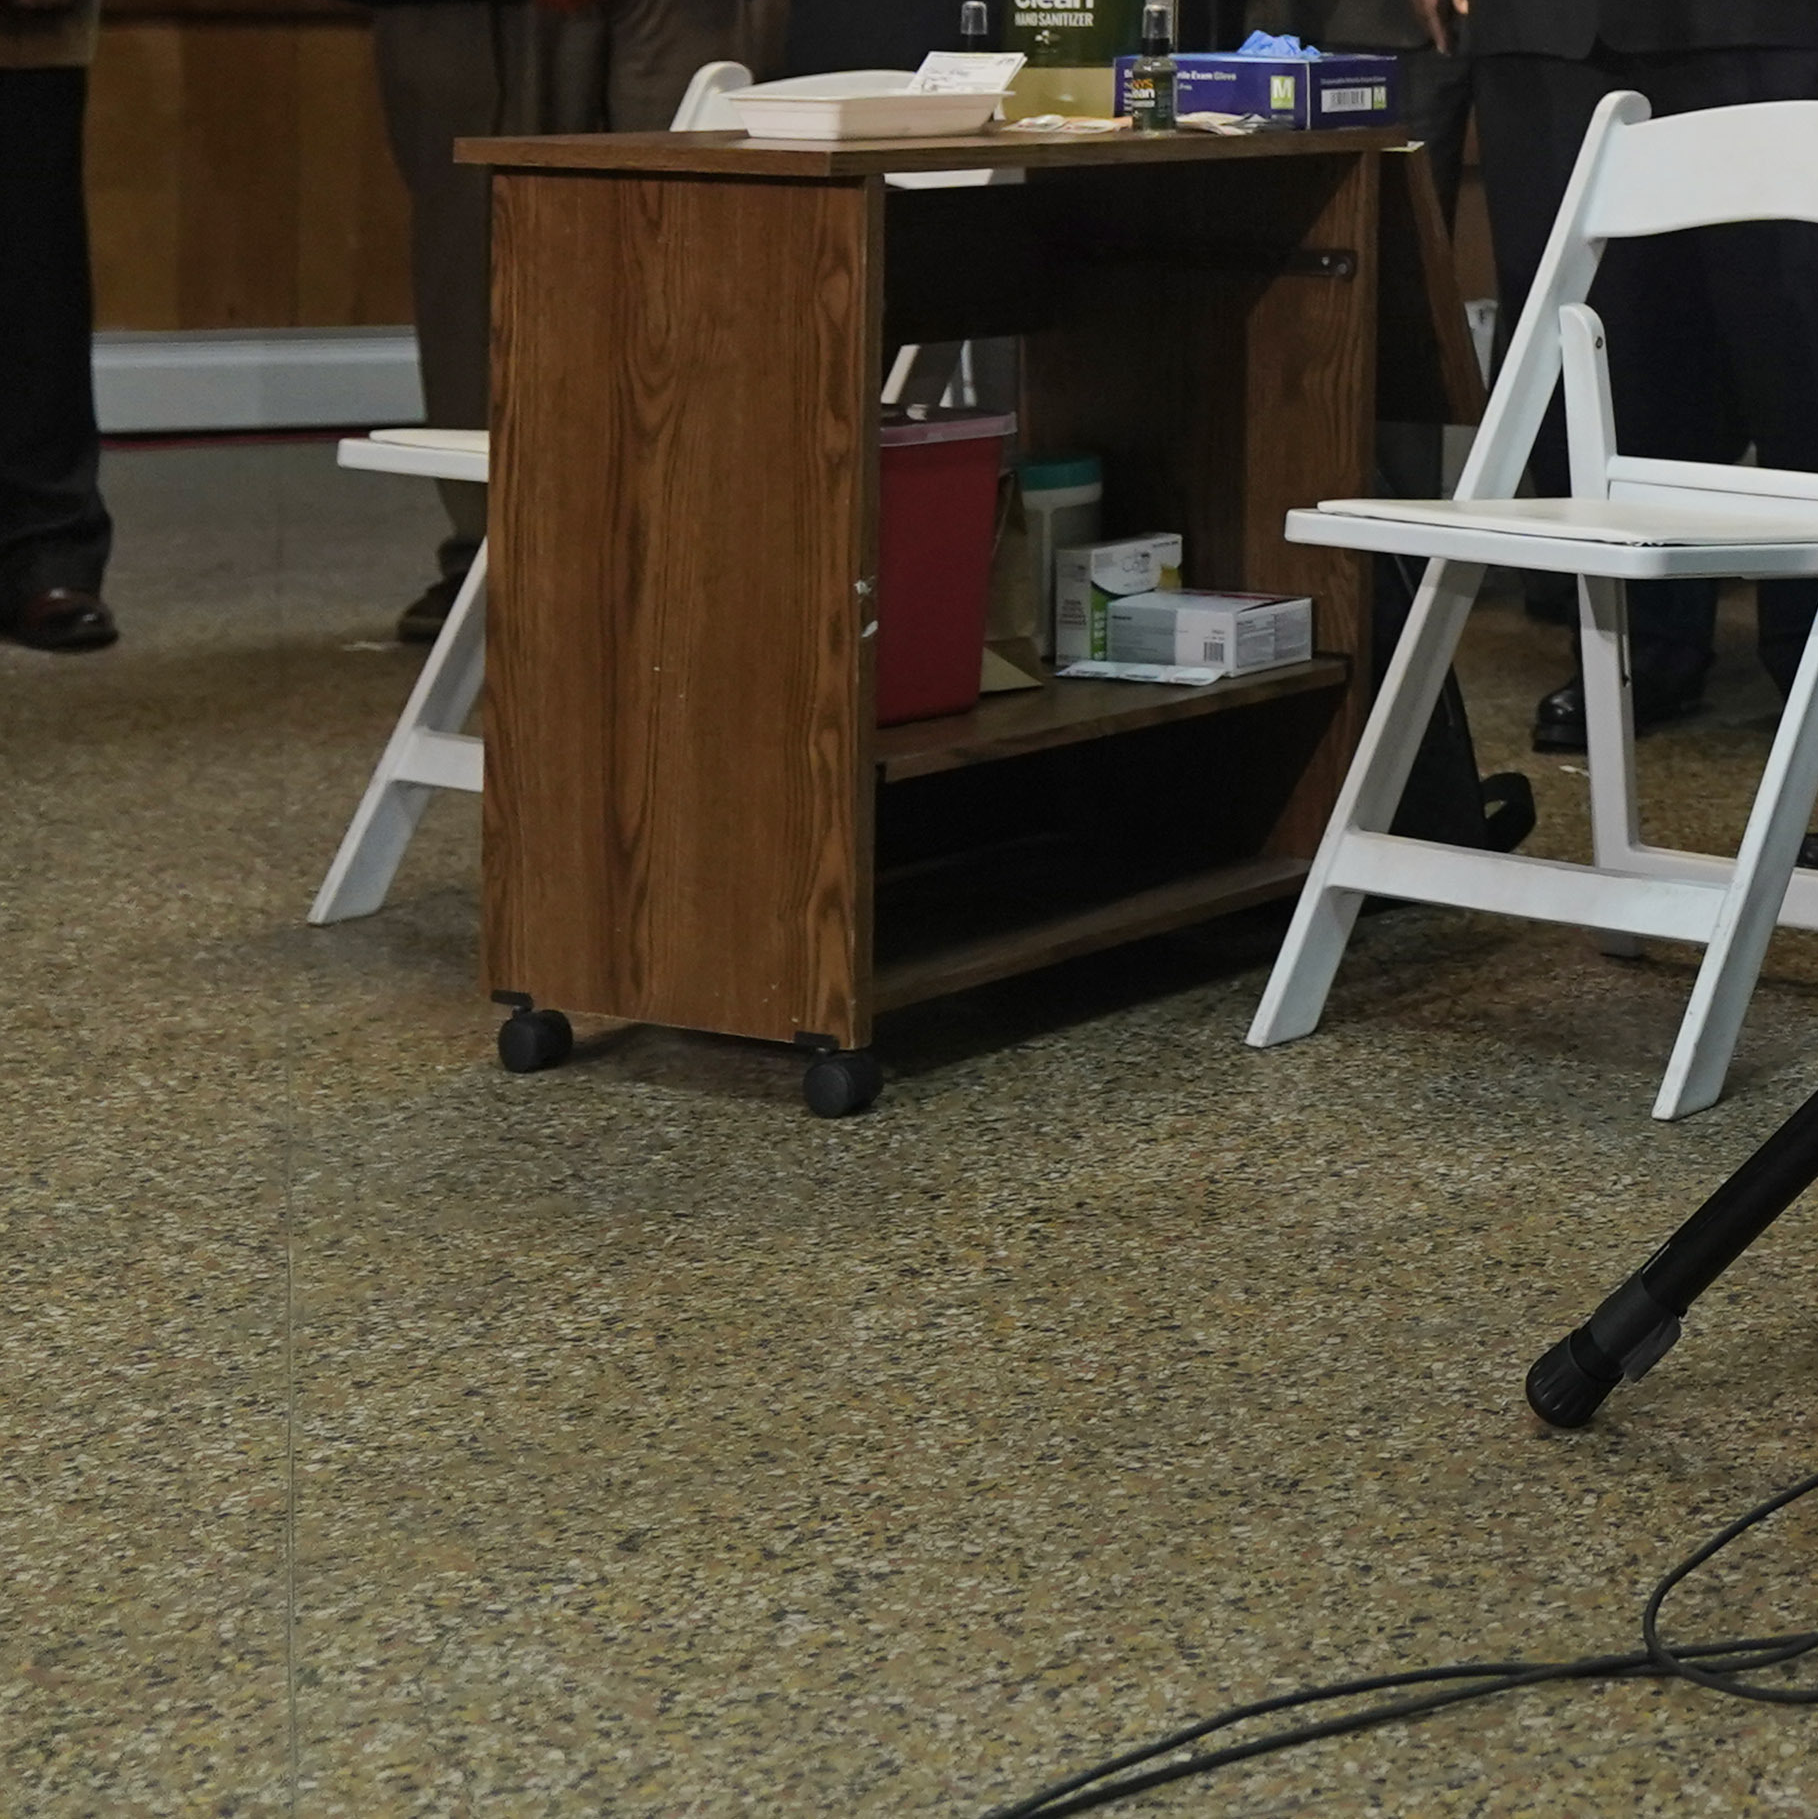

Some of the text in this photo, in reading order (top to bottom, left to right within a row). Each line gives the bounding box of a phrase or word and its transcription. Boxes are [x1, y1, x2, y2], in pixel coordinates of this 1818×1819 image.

[1015, 12, 1094, 27] HAND SANITIZER
[1271, 77, 1293, 99] M
